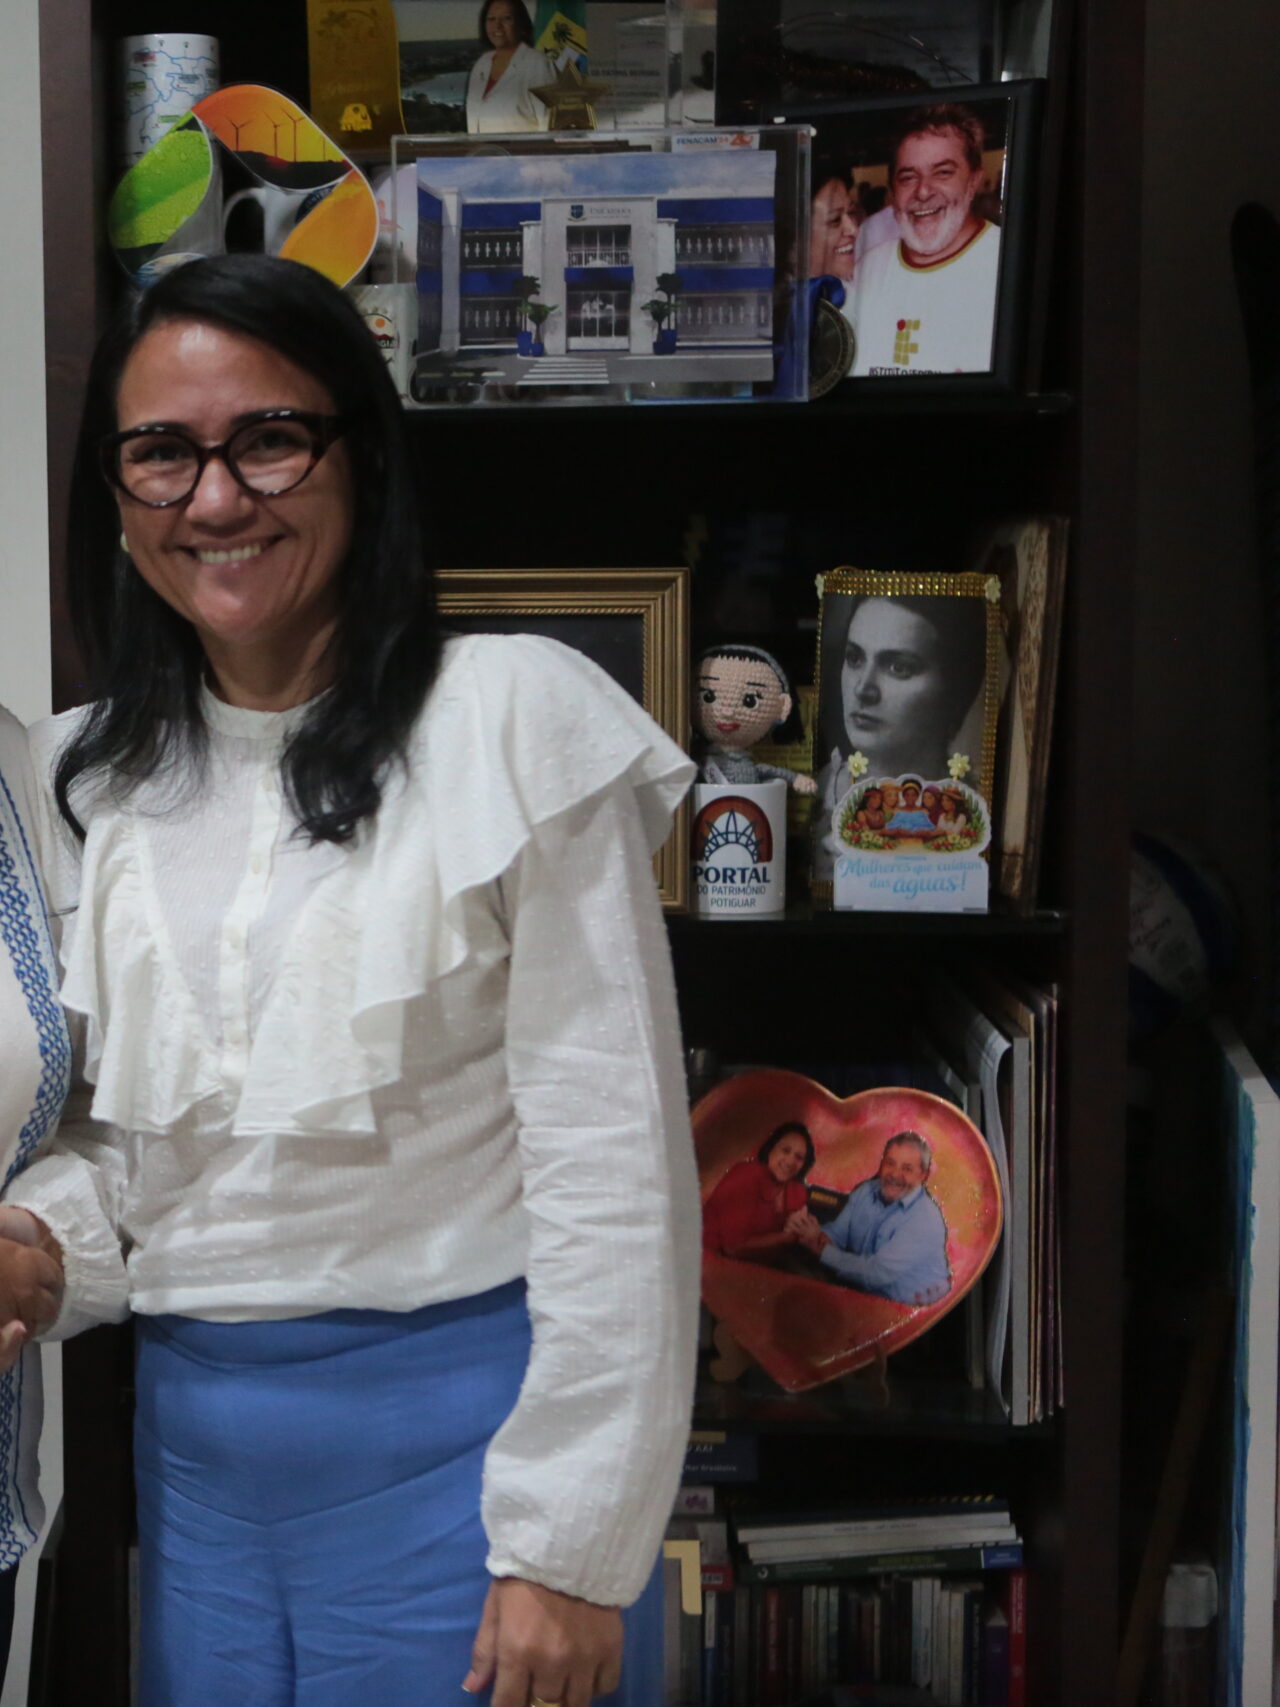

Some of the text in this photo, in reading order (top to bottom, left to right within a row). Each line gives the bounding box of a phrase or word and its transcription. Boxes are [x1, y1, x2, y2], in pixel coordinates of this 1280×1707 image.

[693, 865, 771, 884] PORTAL
[838, 856, 911, 877] Mulheres
[710, 897, 757, 908] POTIGUAR
